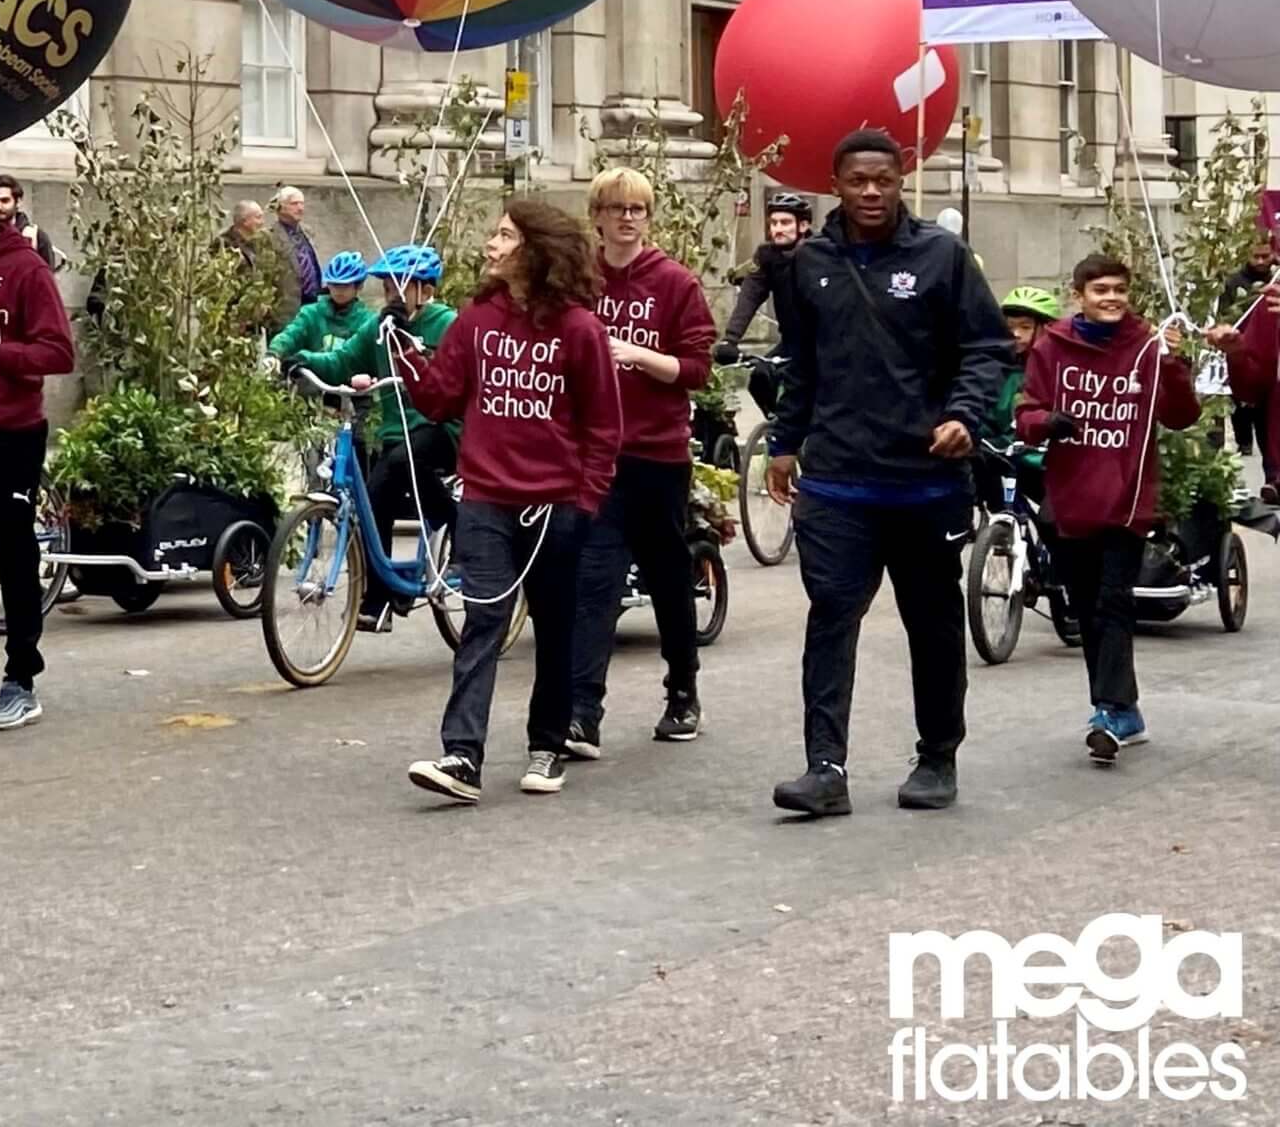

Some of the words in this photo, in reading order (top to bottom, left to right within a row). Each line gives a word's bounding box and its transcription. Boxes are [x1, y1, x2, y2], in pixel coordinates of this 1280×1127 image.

[597, 295, 625, 322] ity
[628, 296, 656, 320] of
[481, 330, 528, 365] City
[531, 338, 562, 364] of
[606, 320, 660, 349] ndon
[481, 359, 566, 394] London
[1062, 365, 1108, 399] City
[481, 388, 553, 421] School
[1061, 392, 1139, 421] London
[1059, 421, 1131, 449] hool
